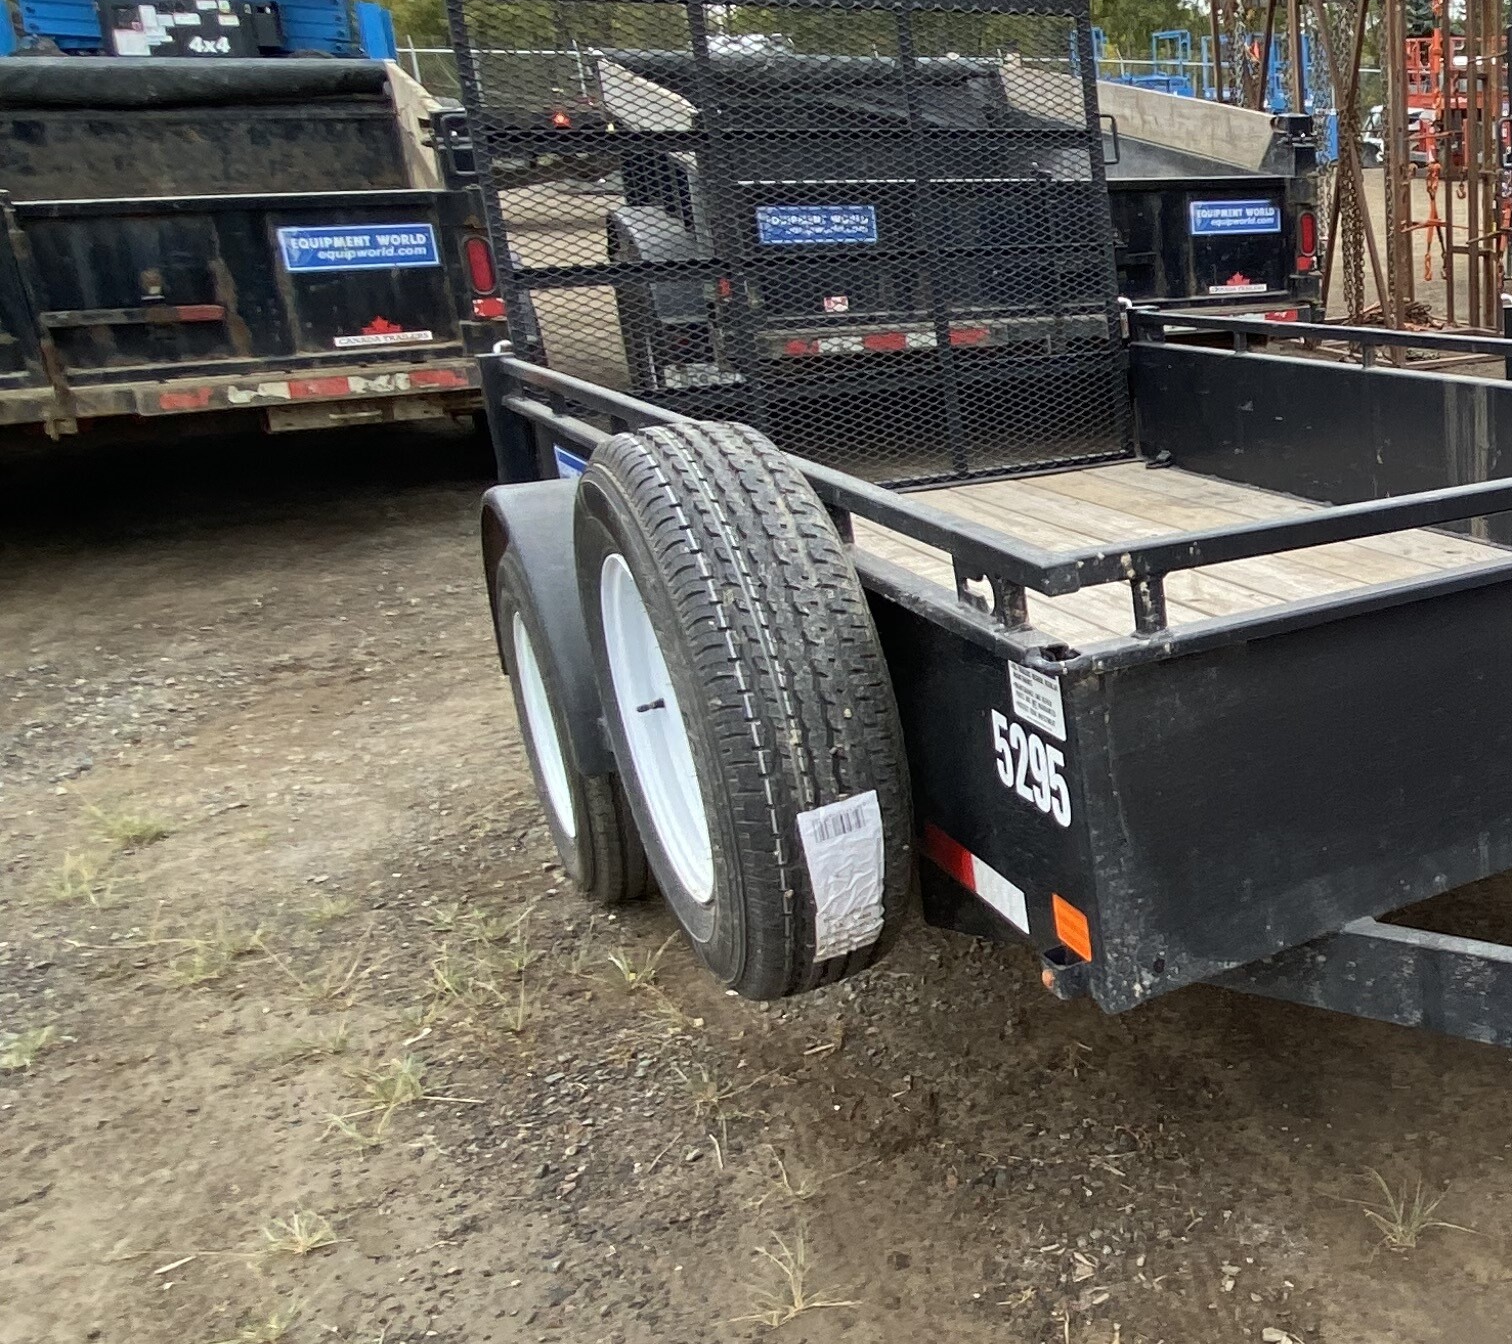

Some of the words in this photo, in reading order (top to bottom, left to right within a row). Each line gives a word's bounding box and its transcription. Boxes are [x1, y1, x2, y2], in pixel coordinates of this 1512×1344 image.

[189, 36, 231, 54] 4x4
[1196, 208, 1243, 218] EQUIPMENT
[1245, 207, 1275, 216] WORLD
[1210, 217, 1274, 227] equipworld.com
[290, 235, 371, 250] EQUIPMENT
[375, 233, 427, 246] WORLD
[317, 246, 427, 261] equipworld.com
[338, 336, 382, 345] CANADA
[991, 709, 1072, 828] 5295
